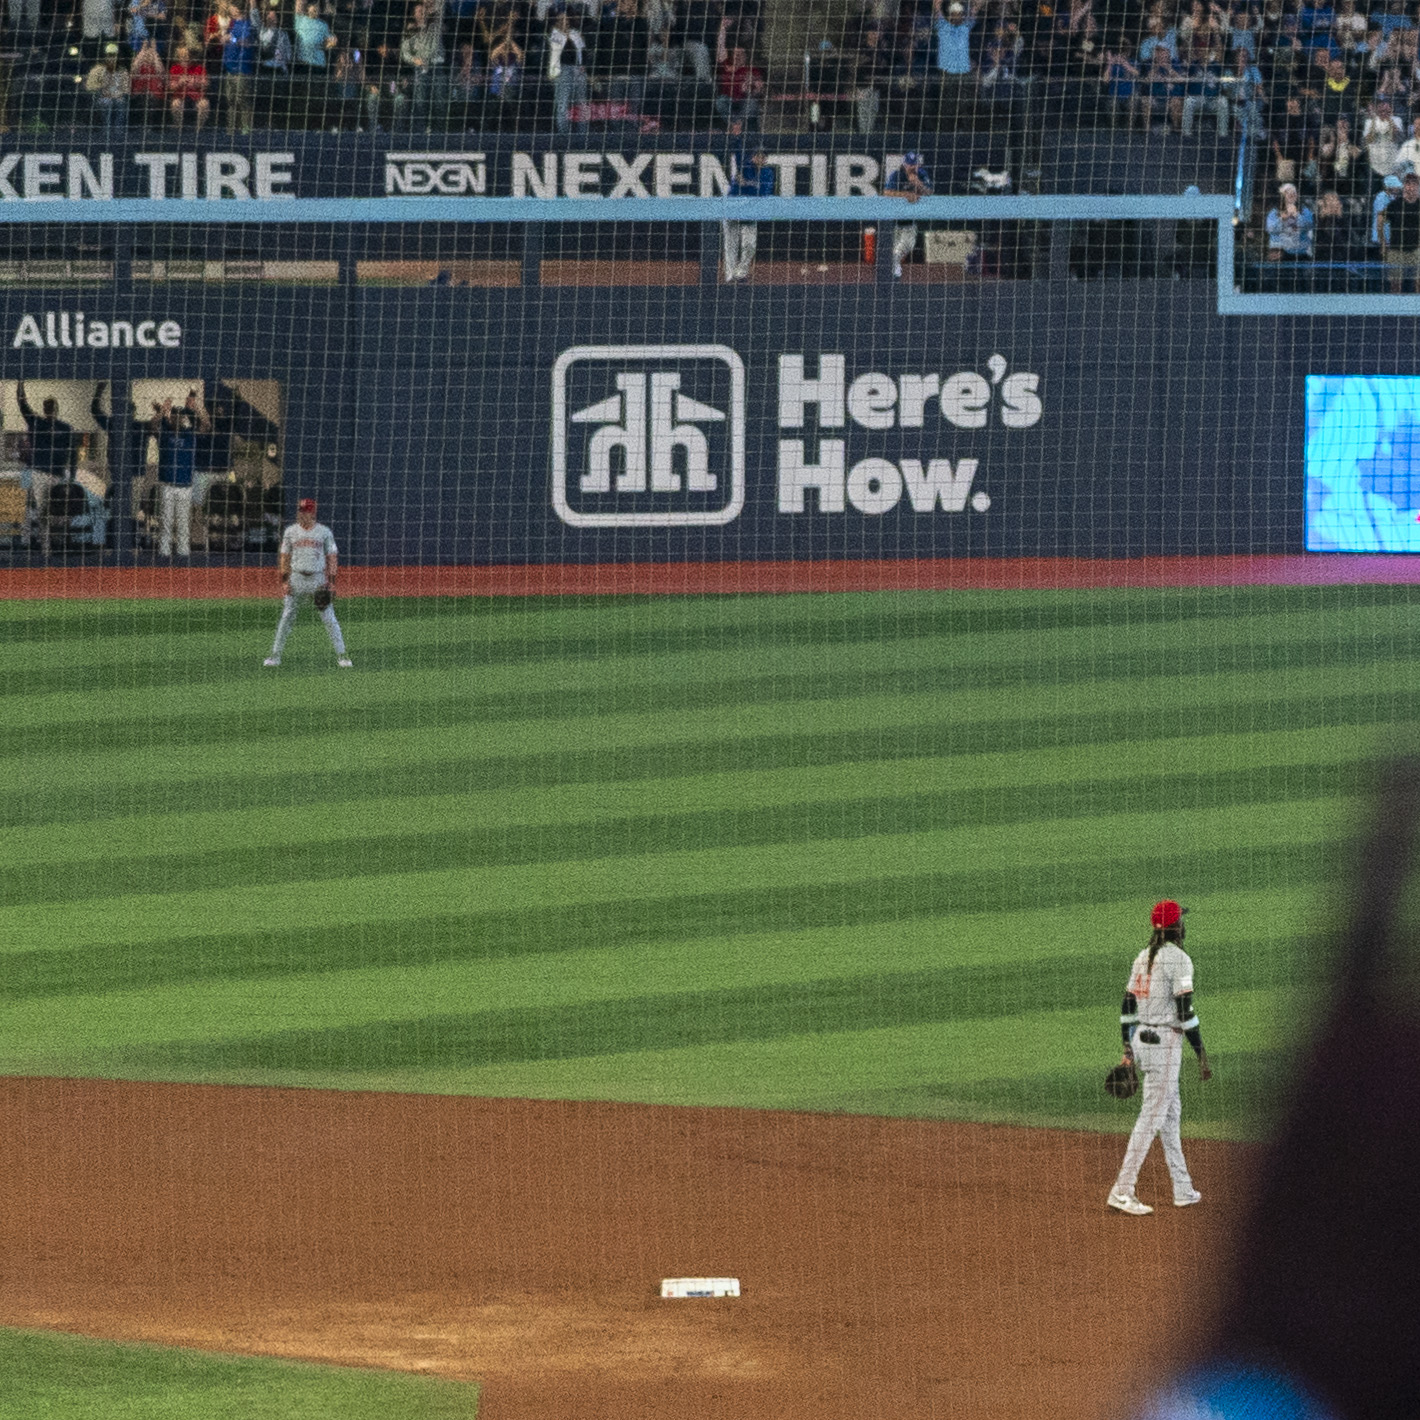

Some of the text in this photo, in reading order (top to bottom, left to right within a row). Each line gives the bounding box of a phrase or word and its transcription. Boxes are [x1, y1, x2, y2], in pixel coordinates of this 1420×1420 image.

[134, 152, 297, 201] TIRE
[385, 162, 486, 194] NEXEN
[511, 152, 738, 199] NEXEN
[13, 312, 182, 349] Alliance
[778, 354, 1043, 430] Here's
[778, 439, 992, 514] How.
